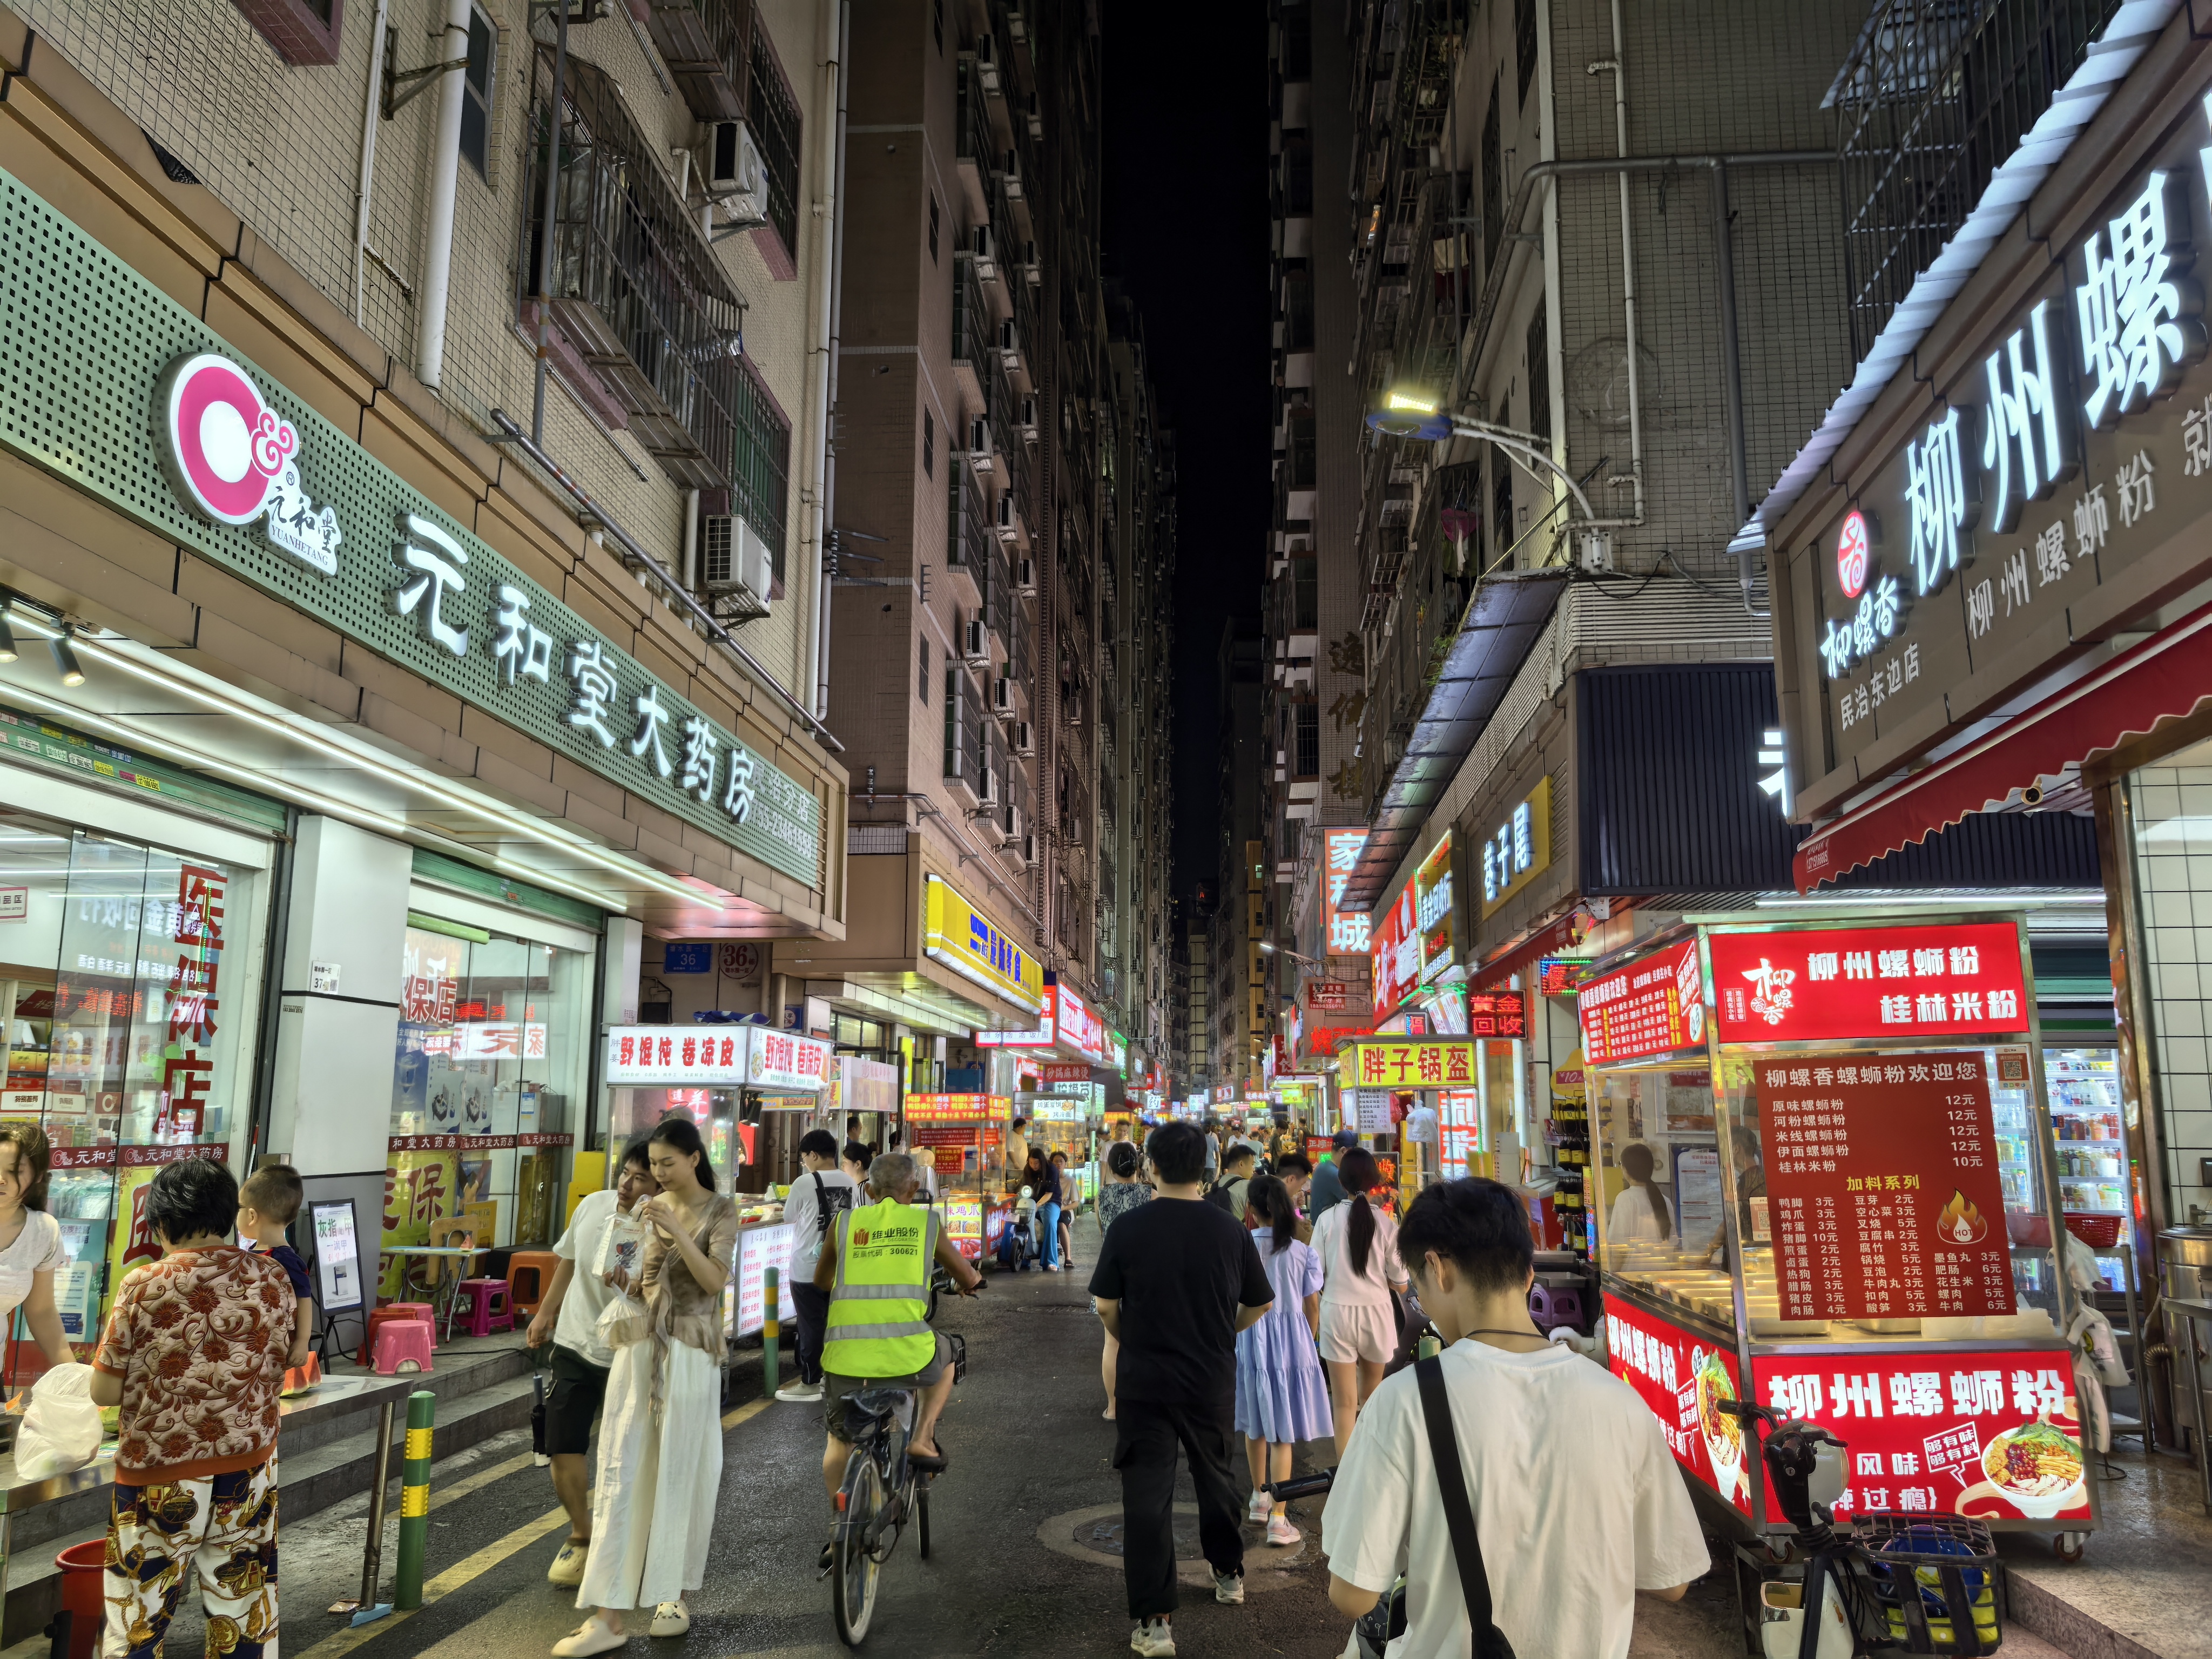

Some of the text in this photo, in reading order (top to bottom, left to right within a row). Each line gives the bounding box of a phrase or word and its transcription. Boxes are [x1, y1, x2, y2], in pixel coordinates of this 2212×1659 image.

[1905, 92, 2212, 596] 柳州螺
[268, 487, 337, 555] 元和堂
[272, 525, 328, 566] YUANHETANG
[1967, 450, 2155, 639] 柳州螺蛳粉
[399, 514, 756, 824] 元和堂大药房
[1840, 642, 1920, 731] 民治东边店
[0, 895, 23, 905] 品区
[680, 954, 696, 965] 36
[724, 945, 747, 966] 36
[1807, 946, 1979, 981] 柳州螺蛳粉
[1471, 994, 1523, 1014] 黄金
[1880, 990, 2017, 1023] 桂林米粉
[1473, 1016, 1524, 1035] 回收
[619, 1036, 672, 1067] 野馄饨
[1362, 1045, 1471, 1084] 胖子锅盔
[1047, 1067, 1089, 1079] 砂锅麻辣烫
[1765, 1062, 1978, 1088] 柳螺香螺蛳粉欢迎您
[1772, 1094, 1975, 1112] 原味螺蛳粉 12元
[1774, 1110, 1978, 1127] 河粉螺蛳粉 12元
[1776, 1124, 1979, 1142] 米线螺蛳粉 12元
[392, 1136, 457, 1149] 和堂大药房
[470, 1136, 515, 1148] 元和堂大药房
[532, 1135, 570, 1145] 元和堂大药房
[145, 1145, 224, 1162] 元和堂大药房
[1777, 1140, 1981, 1158] 伊面螺蛳粉 12元
[75, 1149, 116, 1164] 元和堂
[1778, 1156, 1983, 1173] 桂林米粉 10元
[1846, 1174, 1920, 1192] 加料系列
[1778, 1196, 1835, 1209] 鸭脚 3元
[1854, 1194, 1914, 1206] 豆芽 2元
[1780, 1208, 1836, 1220] 鸡爪 3元
[1856, 1205, 1916, 1218] 空心菜 3元
[1781, 1220, 1837, 1232] 炸蛋 3元
[1857, 1217, 1917, 1230] 叉烧 5元
[872, 1227, 918, 1240] 维业股份
[1782, 1232, 1838, 1244] 猪脚 10元
[1858, 1230, 1918, 1242] 豆腐串 2元
[1954, 1228, 1973, 1237] HOT
[1784, 1244, 1839, 1256] 煎蛋 2元
[1860, 1242, 1920, 1253] 腐竹 3元
[1785, 1256, 1841, 1268] 卤蛋 2元
[1860, 1253, 1921, 1265] 锅烧 5元
[1934, 1251, 2000, 1264] 墨鱼丸 3元
[1786, 1268, 1843, 1280] 热狗 2元
[1862, 1265, 1923, 1277] 豆泡 2元
[1935, 1264, 2002, 1276] 肥肠 6元
[1788, 1280, 1844, 1292] 腊肠 3元
[1863, 1277, 1924, 1290] 牛肉丸 3元
[1936, 1275, 2003, 1288] 花生米 3元
[1789, 1292, 1845, 1304] 猪皮 3元
[1865, 1290, 1925, 1301] 扣肉 5元
[1938, 1287, 2005, 1300] 螺肉 5元
[1791, 1304, 1846, 1316] 肉肠 4元
[1866, 1301, 1927, 1313] 酸笋 3元
[1939, 1299, 2007, 1312] 牛肉 6元
[1607, 1312, 1677, 1394] 柳州螺蛳粉
[1768, 1370, 2066, 1420] 柳州螺蛳粉
[1926, 1428, 1975, 1454] 够有味
[1857, 1453, 1919, 1476] 风味
